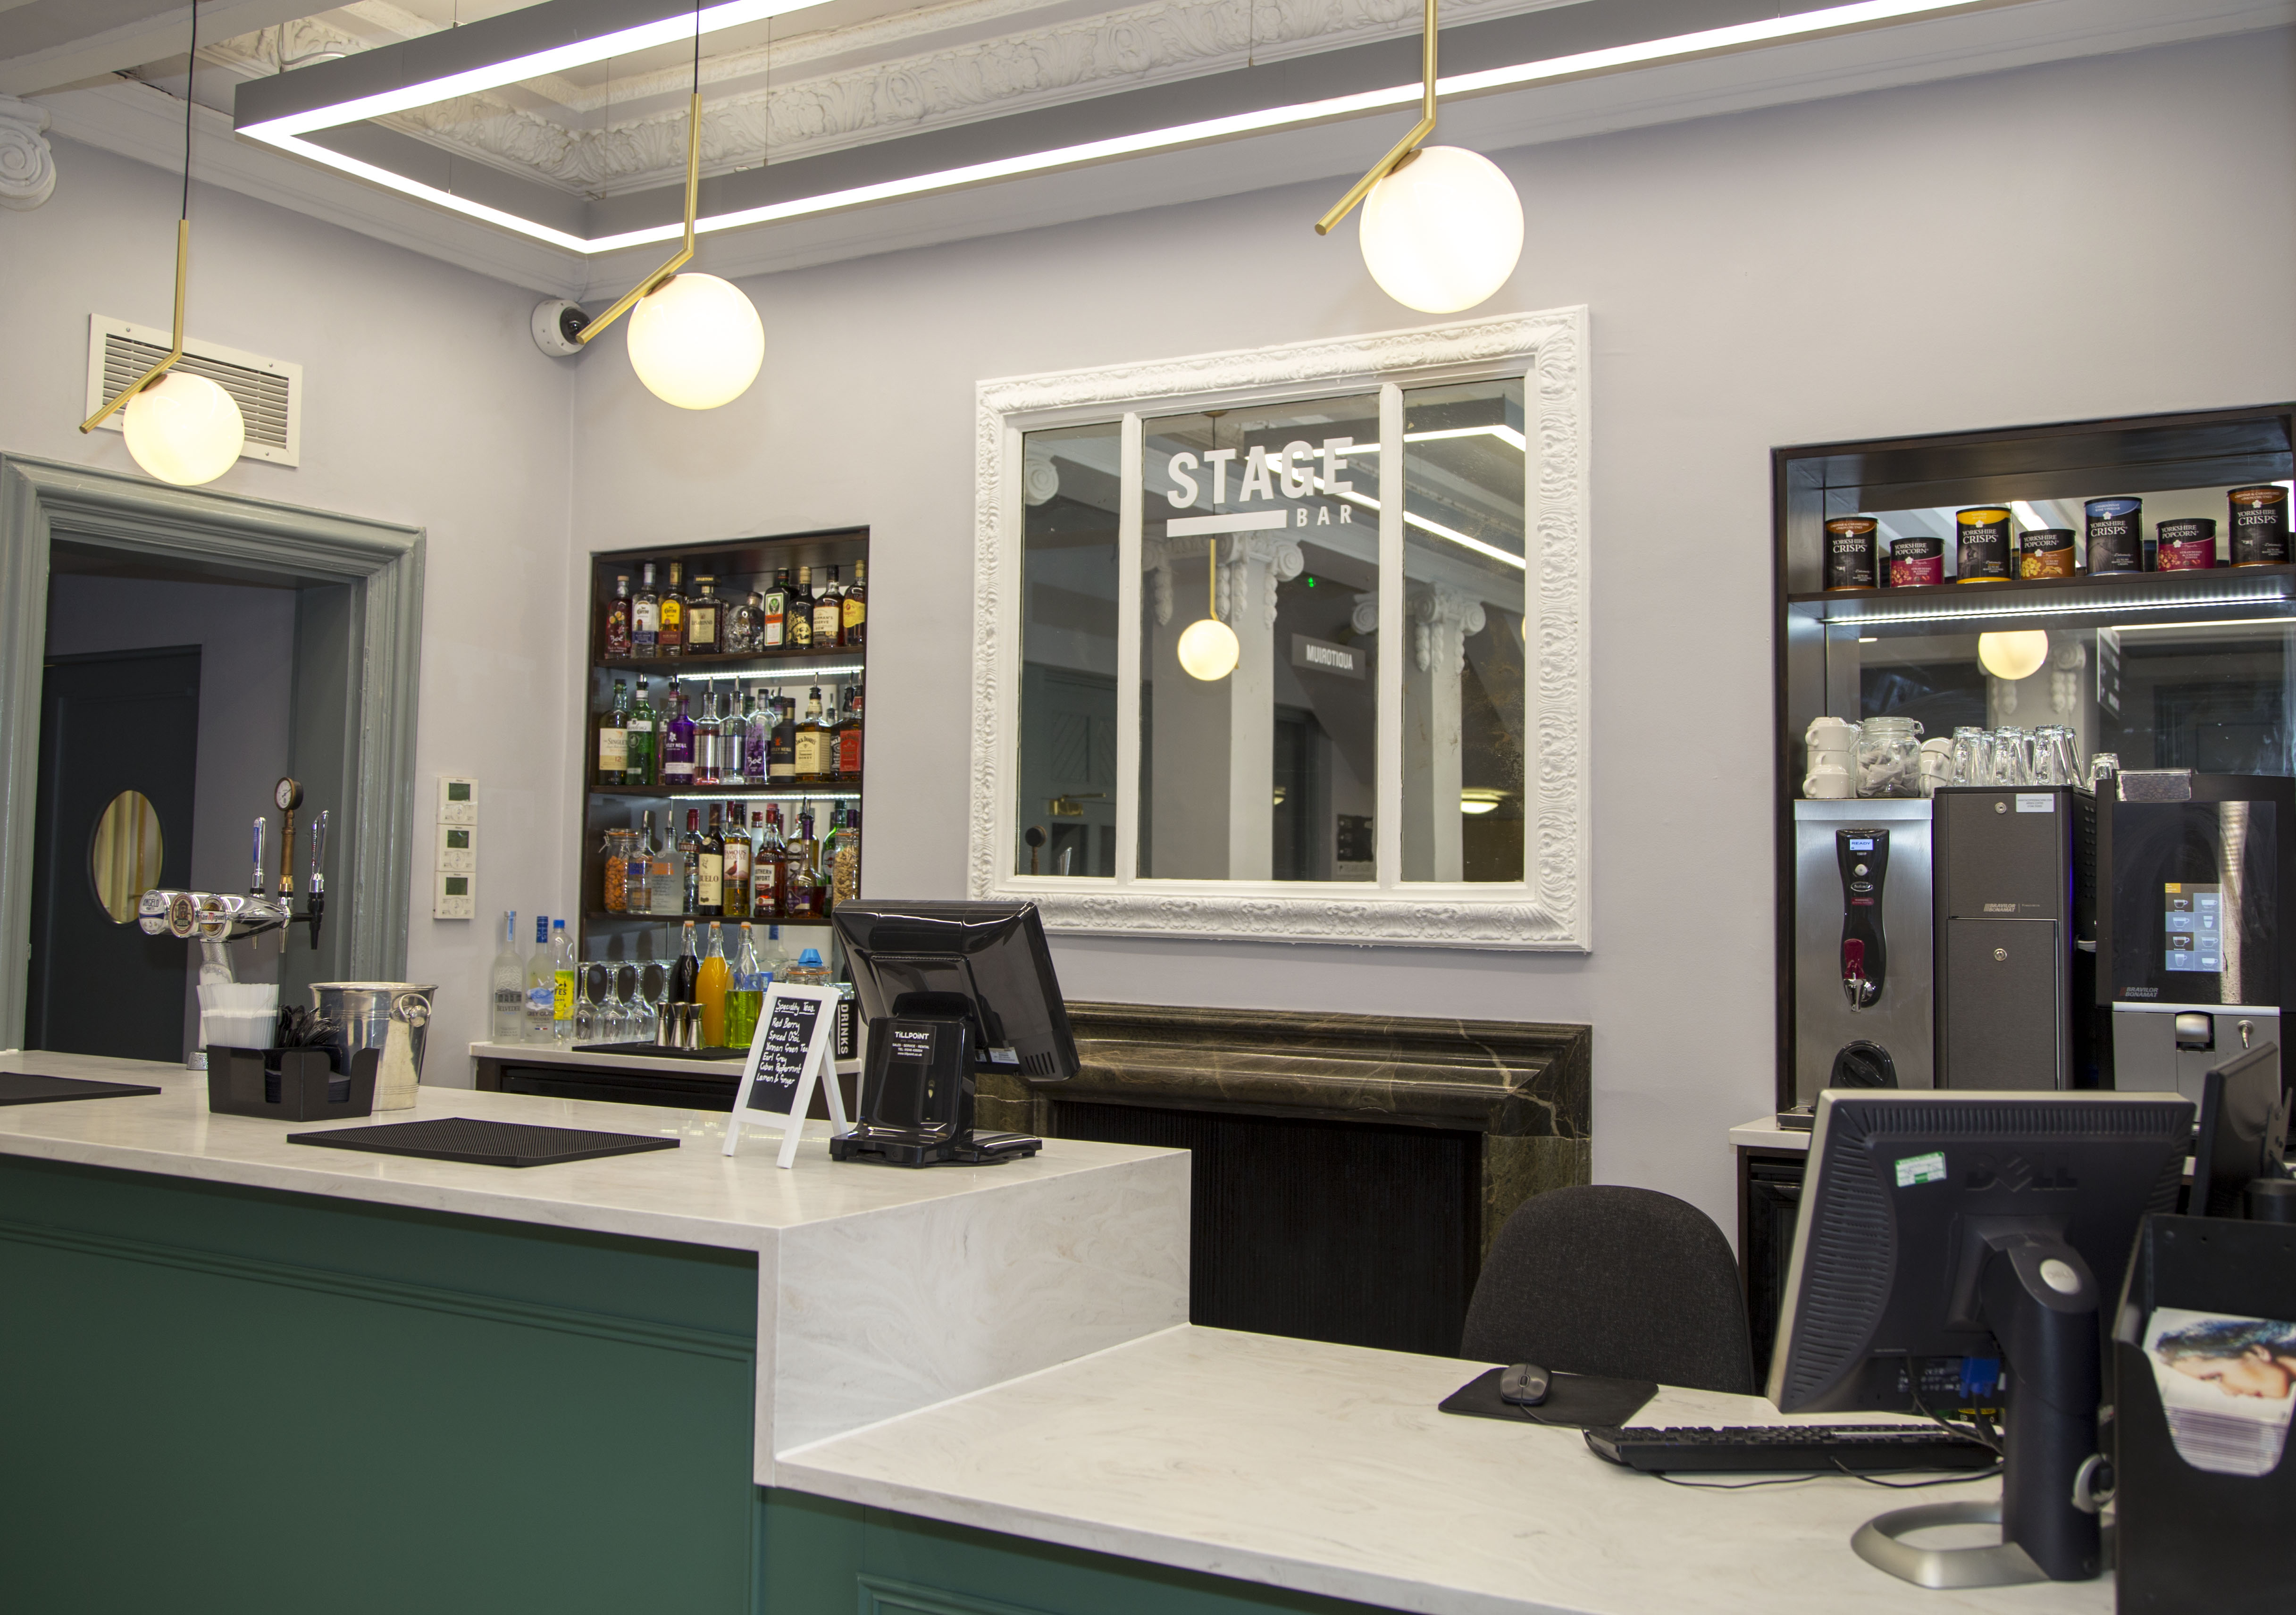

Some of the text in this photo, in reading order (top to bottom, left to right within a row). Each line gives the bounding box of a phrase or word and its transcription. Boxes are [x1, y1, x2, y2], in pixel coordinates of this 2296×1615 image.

[1166, 436, 1354, 509] STAGE
[1296, 504, 1352, 527] BAR
[2238, 516, 2276, 526] CRISPS
[2091, 527, 2126, 537] CRISPS
[2162, 525, 2197, 533] YORKSHIRE
[1963, 535, 1997, 544] CRISPS
[2162, 531, 2196, 539] POPCORN
[1833, 544, 1866, 553] CRISPS
[2025, 540, 2057, 548] POPCORN
[804, 736, 816, 745] DANIEL'S
[208, 912, 225, 922] Miguel
[772, 1017, 800, 1036] Red Berry
[840, 1004, 849, 1054] DRINKS
[769, 1030, 787, 1041] Spiced
[785, 1043, 798, 1053] Green
[800, 1044, 808, 1053] Tea
[763, 1052, 788, 1066] Earl Grey
[760, 1062, 802, 1074] Cuban Peppermint
[756, 1073, 773, 1082] Lemon
[780, 1074, 795, 1088] Ginger
